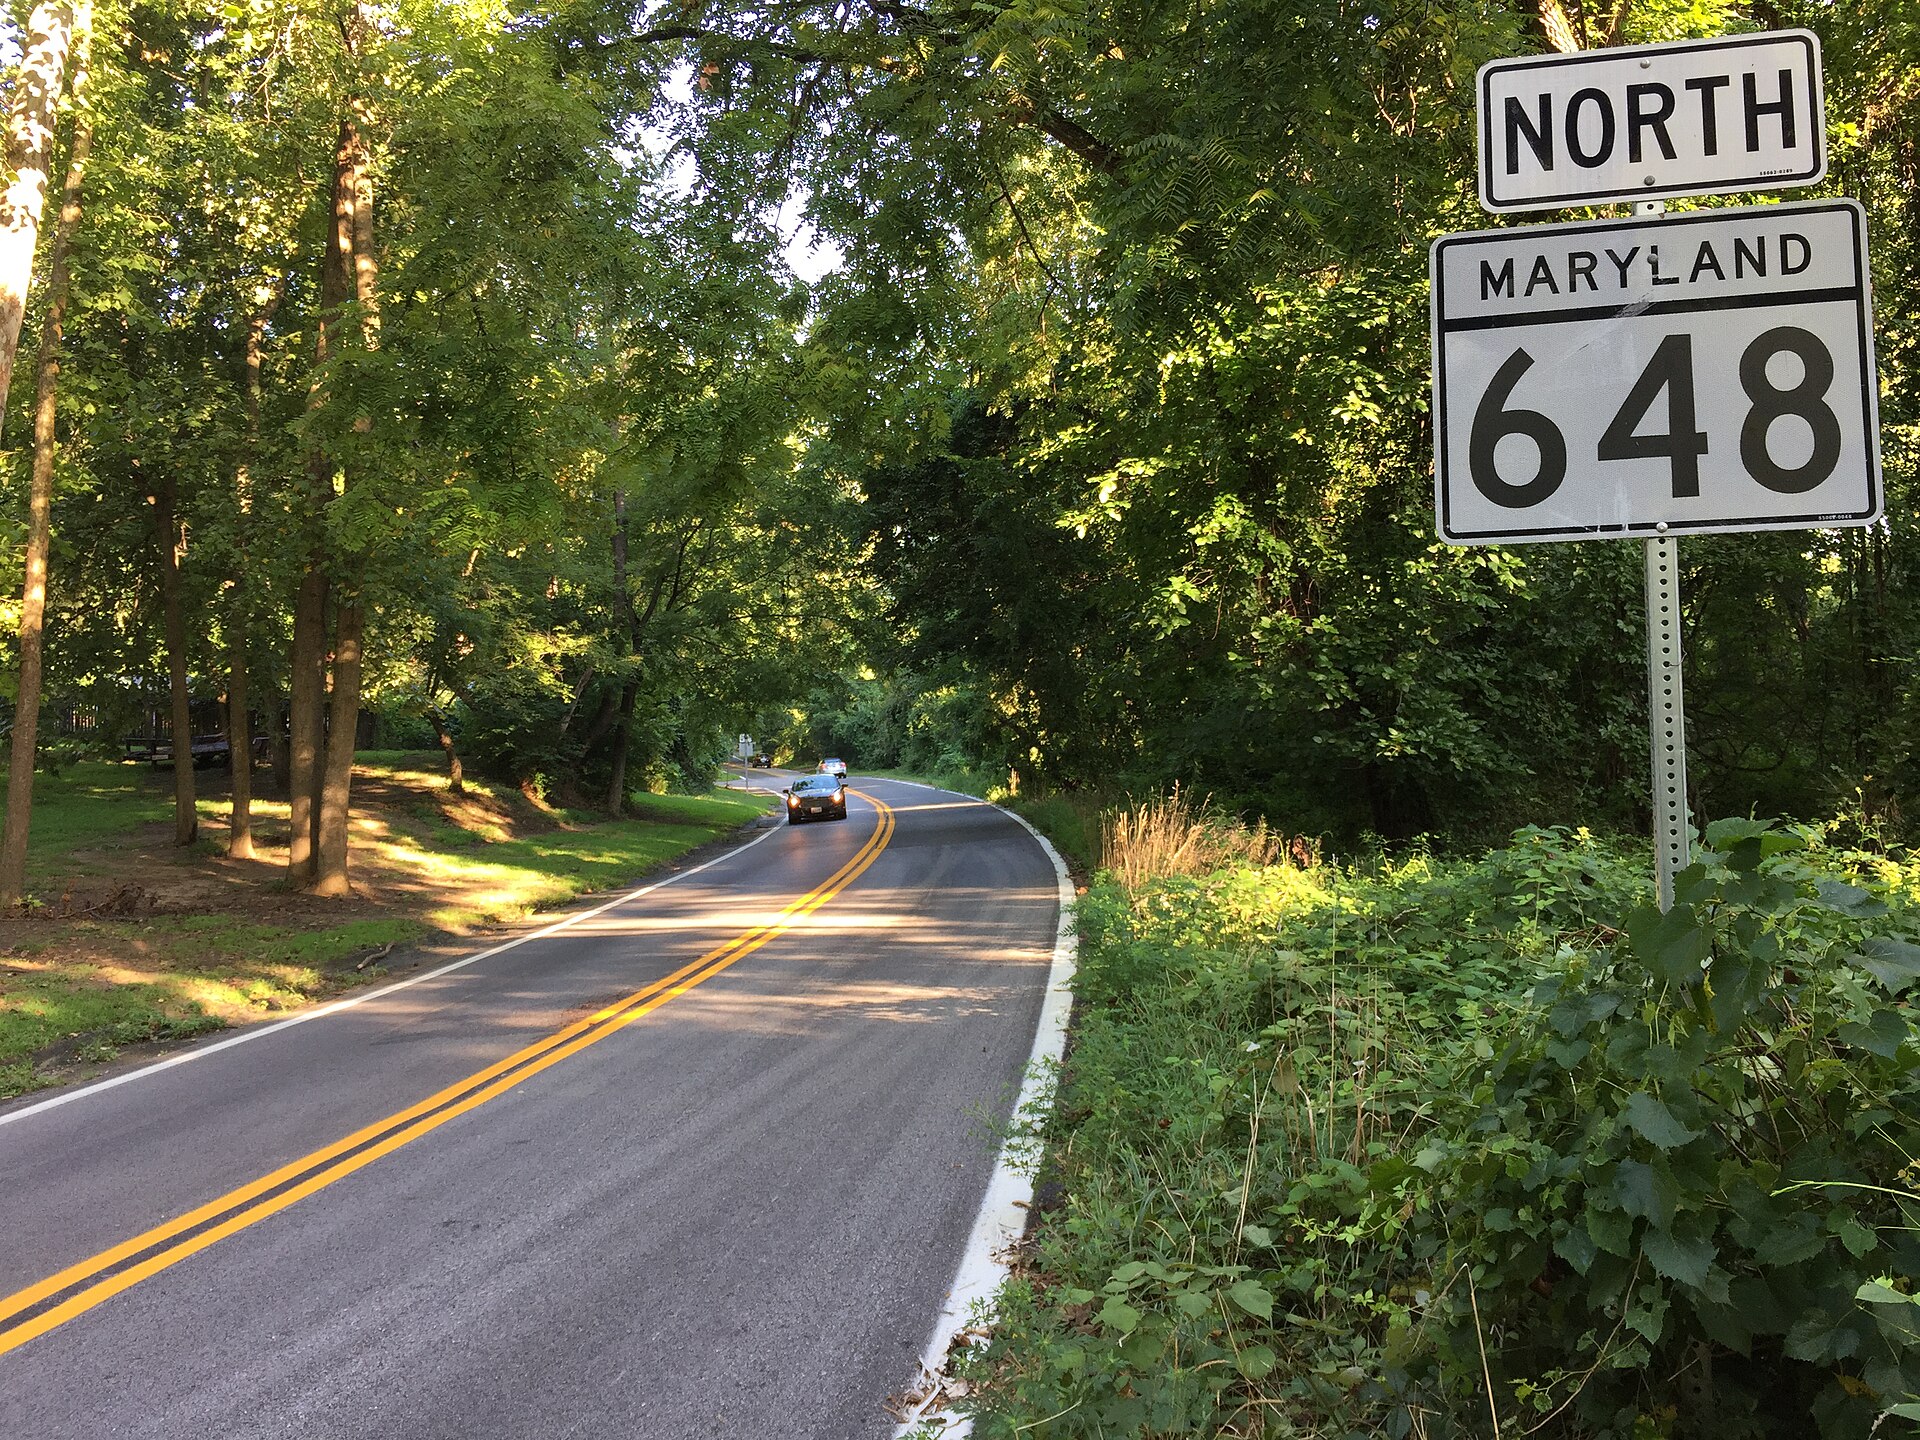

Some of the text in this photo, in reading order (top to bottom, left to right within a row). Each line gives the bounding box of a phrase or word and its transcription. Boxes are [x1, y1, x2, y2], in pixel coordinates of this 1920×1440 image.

[1505, 69, 1796, 175] NORTH
[1480, 234, 1811, 300] MARYLAND
[1469, 326, 1841, 508] 648
